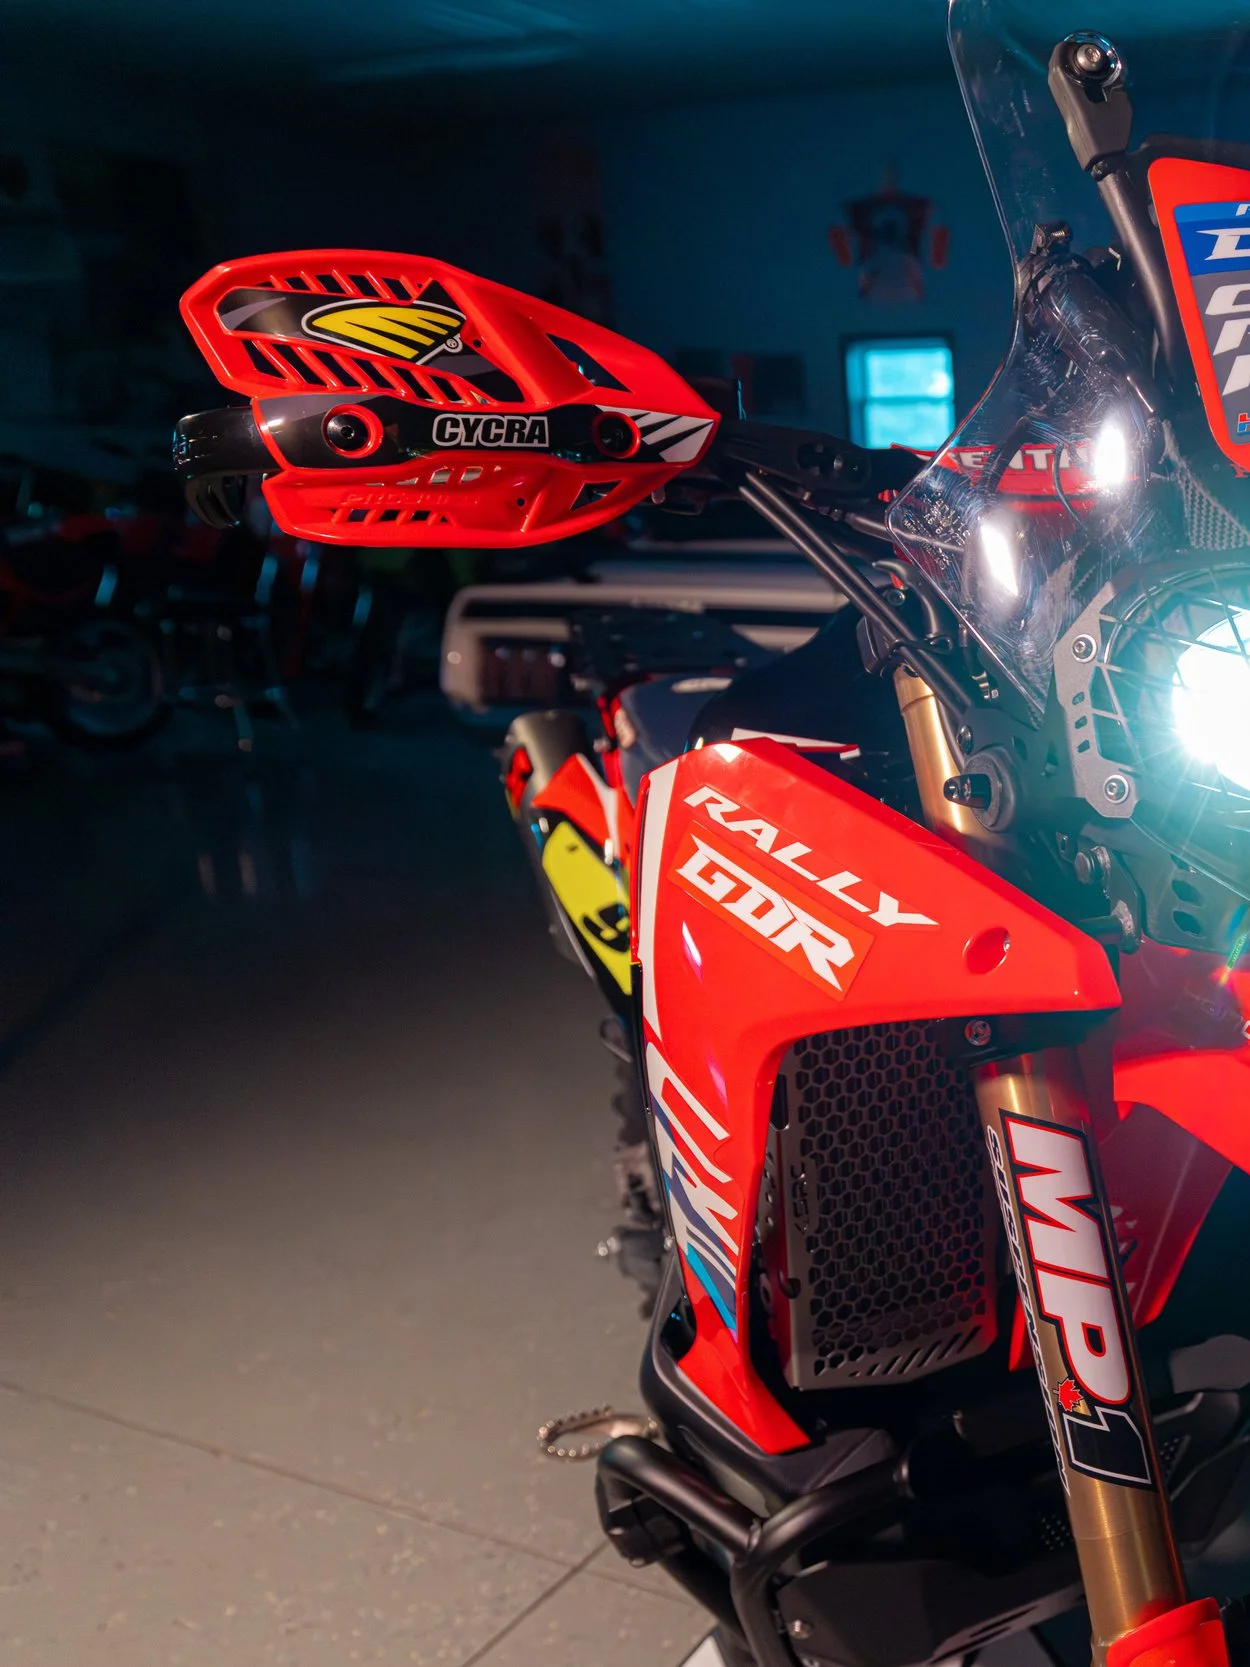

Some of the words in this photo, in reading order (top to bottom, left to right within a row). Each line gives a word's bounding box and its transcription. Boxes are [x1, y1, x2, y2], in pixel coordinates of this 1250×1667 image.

[432, 413, 549, 448] CYCRA
[675, 833, 855, 992] GDR
[683, 785, 940, 927] RALLY
[1003, 1114, 1153, 1486] MP1
